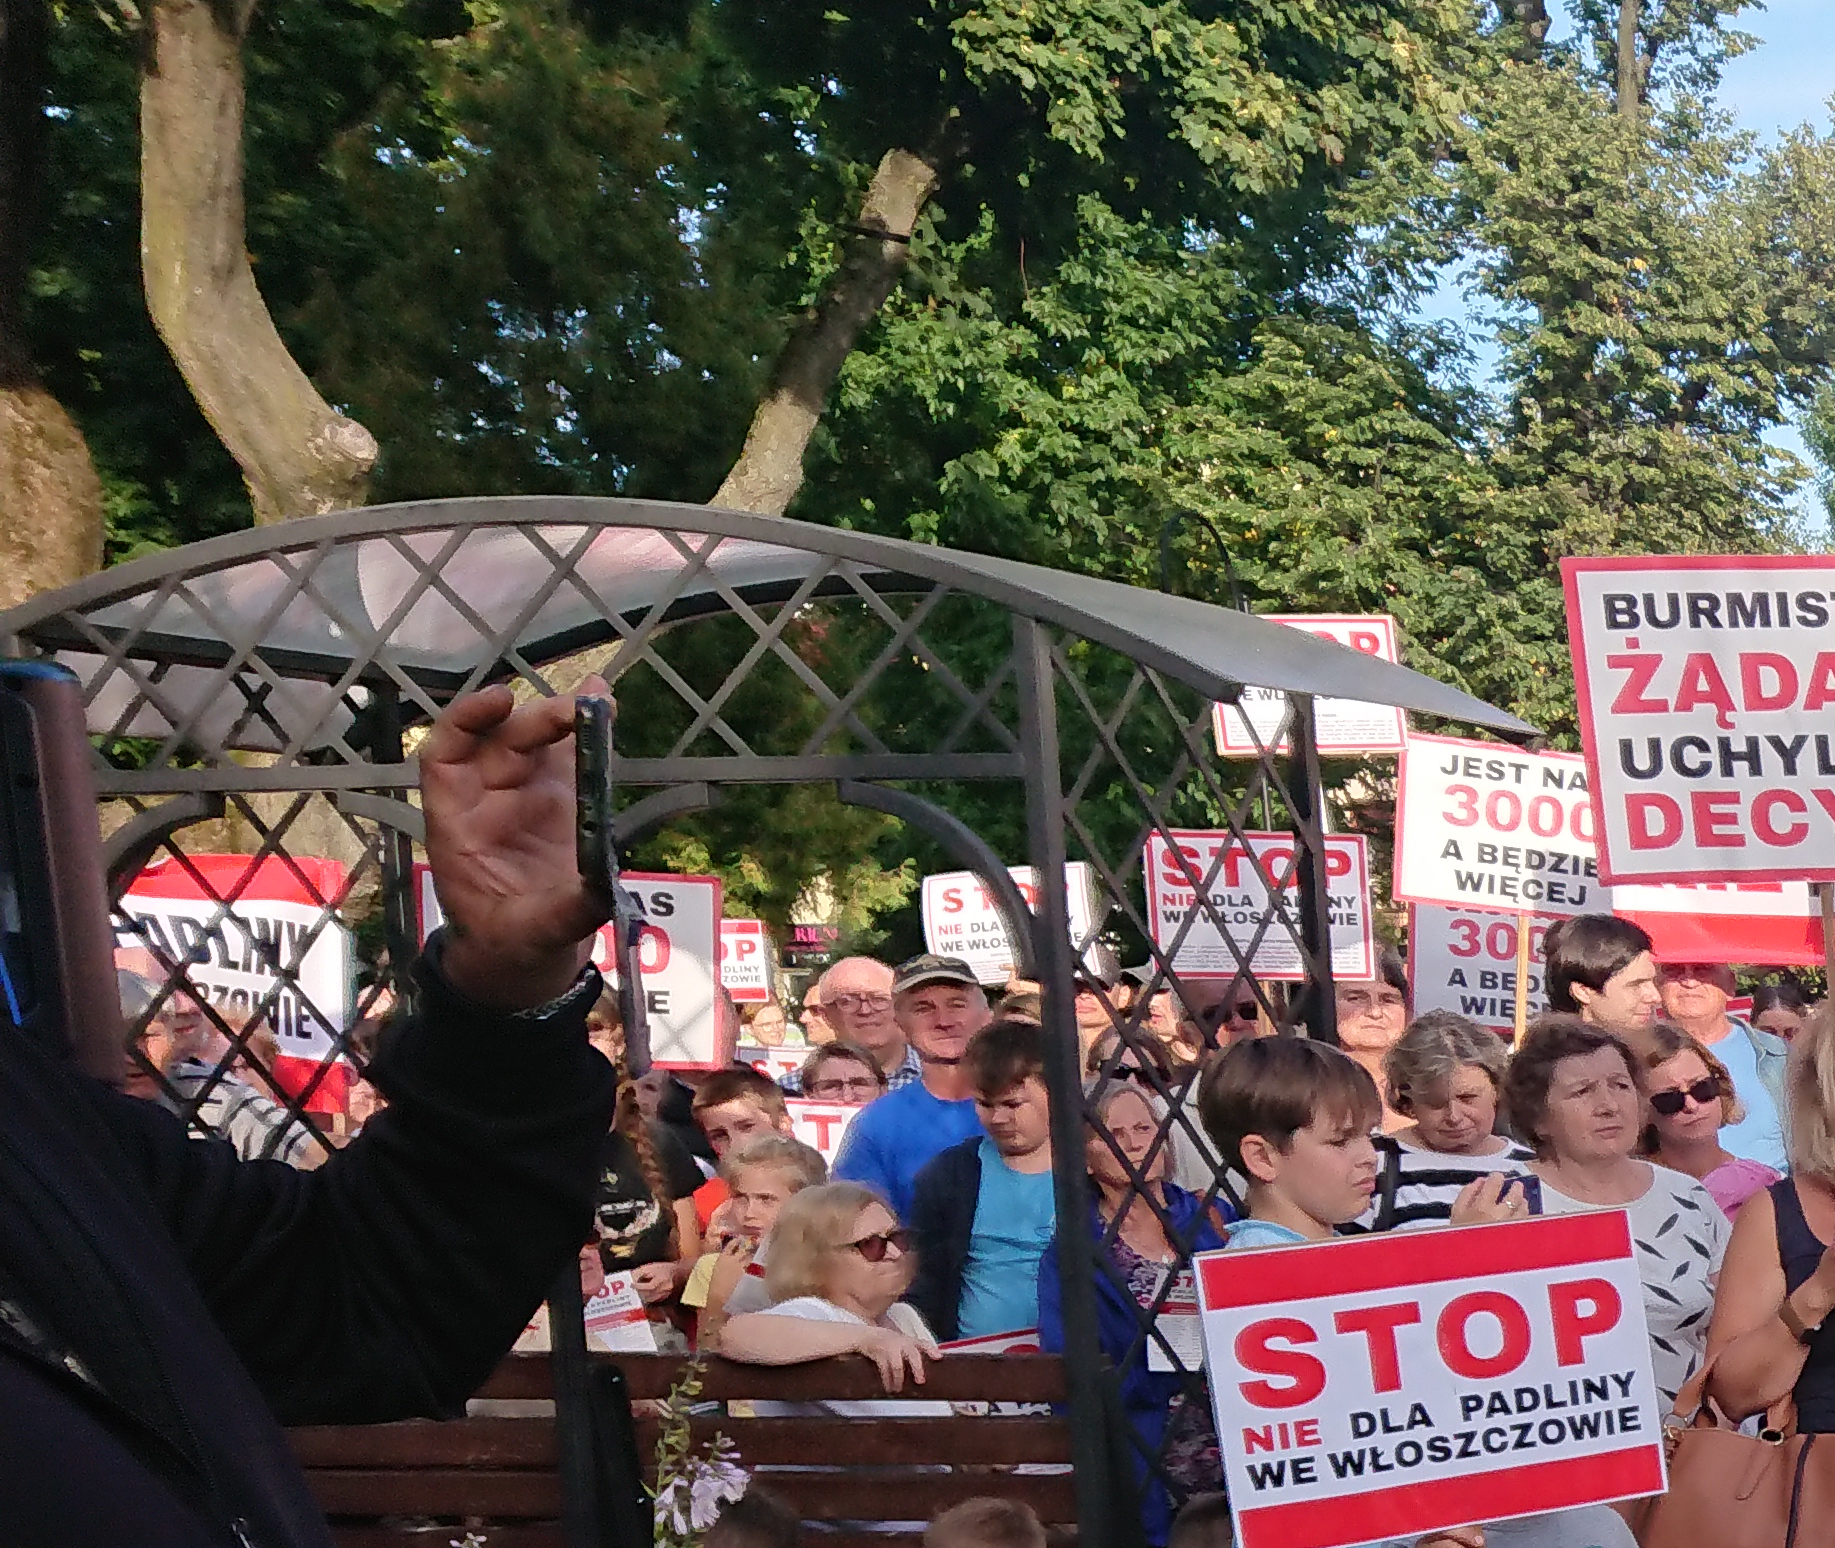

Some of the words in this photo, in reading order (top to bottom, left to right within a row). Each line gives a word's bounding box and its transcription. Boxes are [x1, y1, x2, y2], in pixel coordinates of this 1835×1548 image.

[1439, 754, 1530, 785] JEST
[1542, 766, 1588, 792] NA
[1439, 838, 1464, 862] A
[1477, 841, 1598, 878] BĘDZIE
[1213, 893, 1254, 907] DLA
[1454, 869, 1588, 906] WIĘCEJ
[938, 922, 963, 937] NIE
[970, 922, 1000, 934] DLA
[940, 940, 965, 953] WE
[1446, 967, 1468, 988] A
[1233, 1276, 1623, 1410] STOP
[1242, 1418, 1322, 1455] NIE
[1349, 1401, 1435, 1440] DLA
[1459, 1370, 1637, 1423] PADLINY
[1245, 1455, 1319, 1491] WE
[1327, 1404, 1643, 1481] WŁOSZCZOWIE
